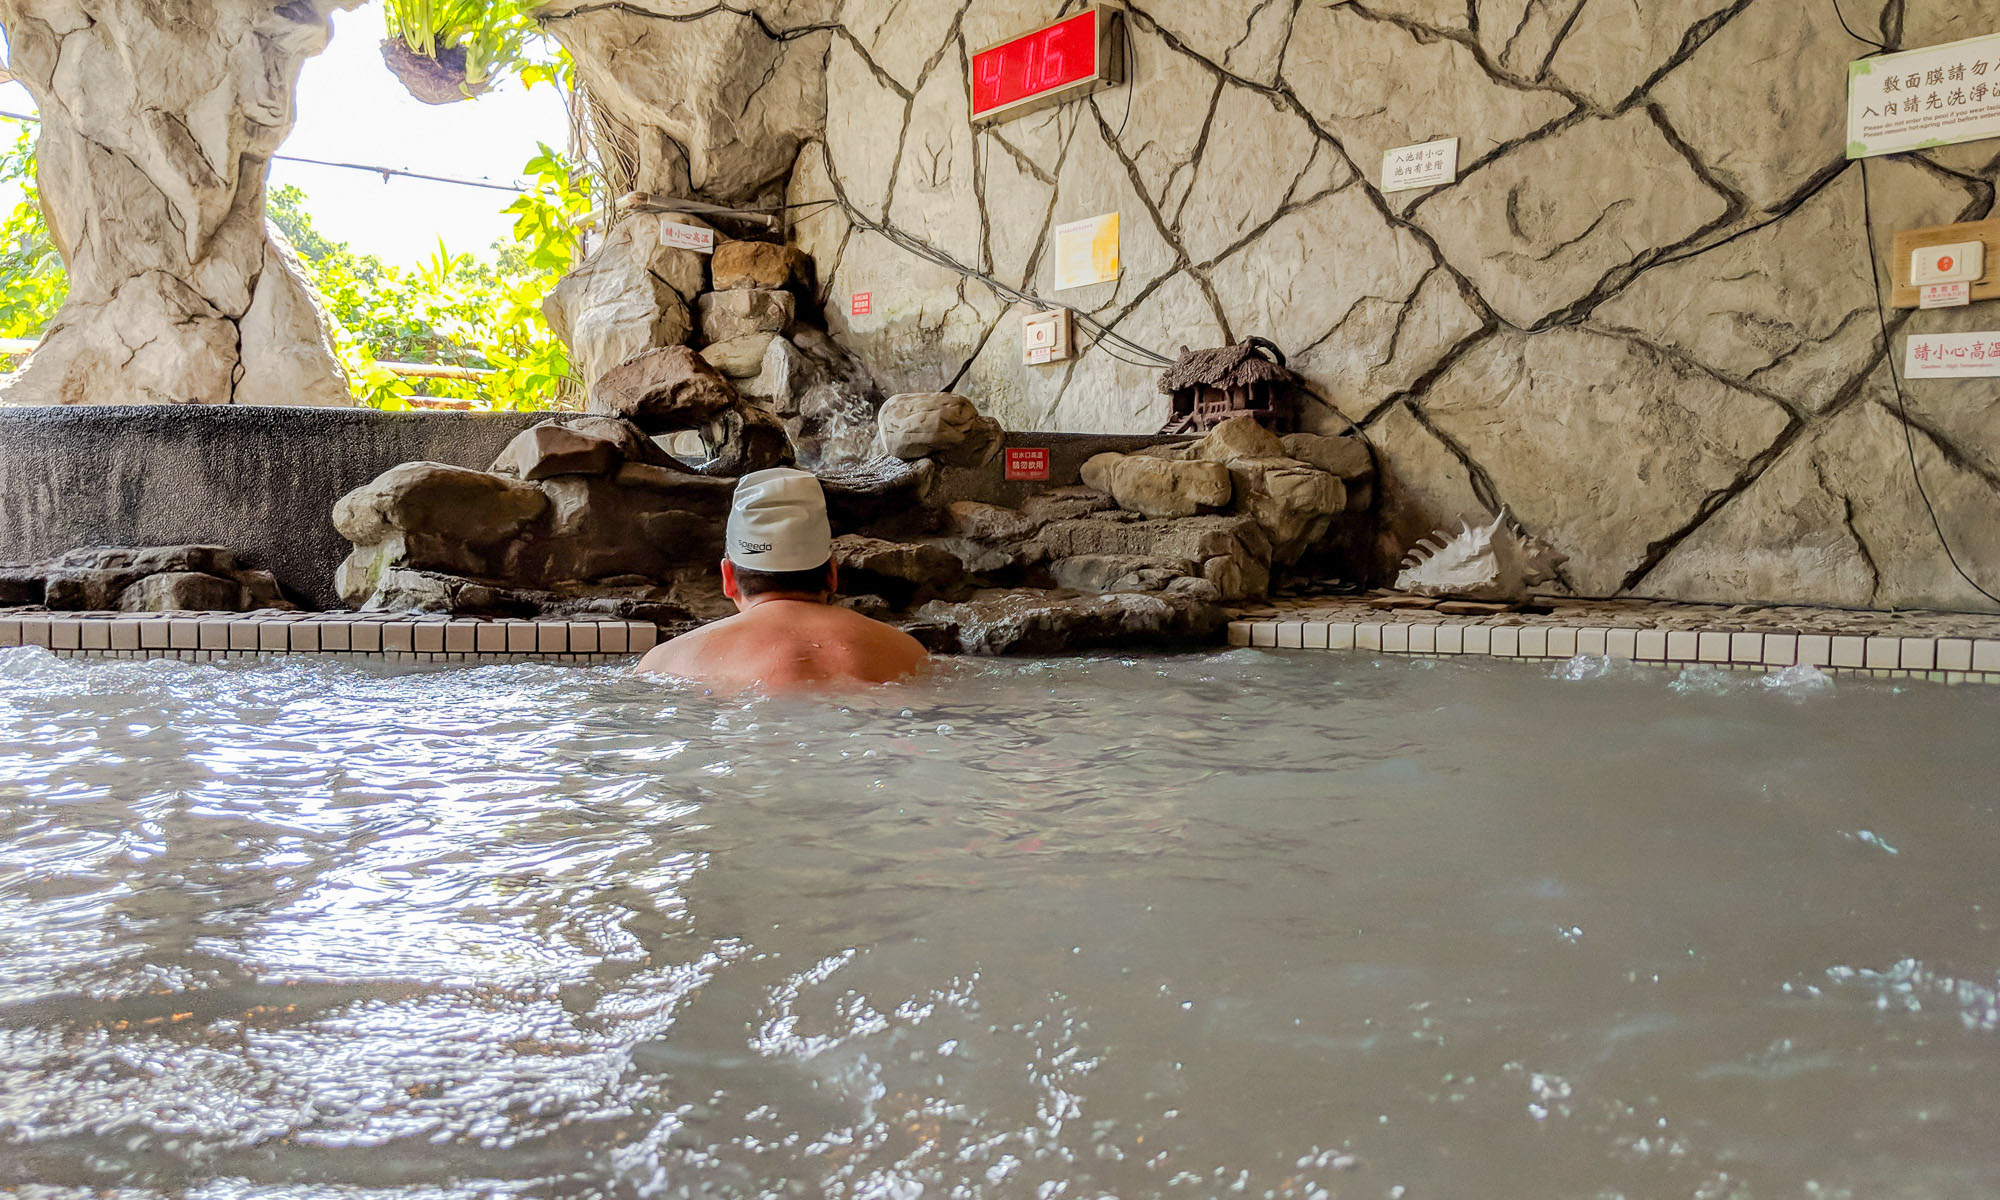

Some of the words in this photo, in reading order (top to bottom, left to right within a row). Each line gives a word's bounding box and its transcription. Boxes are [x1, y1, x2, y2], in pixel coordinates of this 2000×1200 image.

[1934, 113, 1949, 121] pool
[1395, 149, 1445, 163] 入池請小心
[1914, 340, 2000, 361] 請小心高溫
[738, 539, 772, 551] speedo
